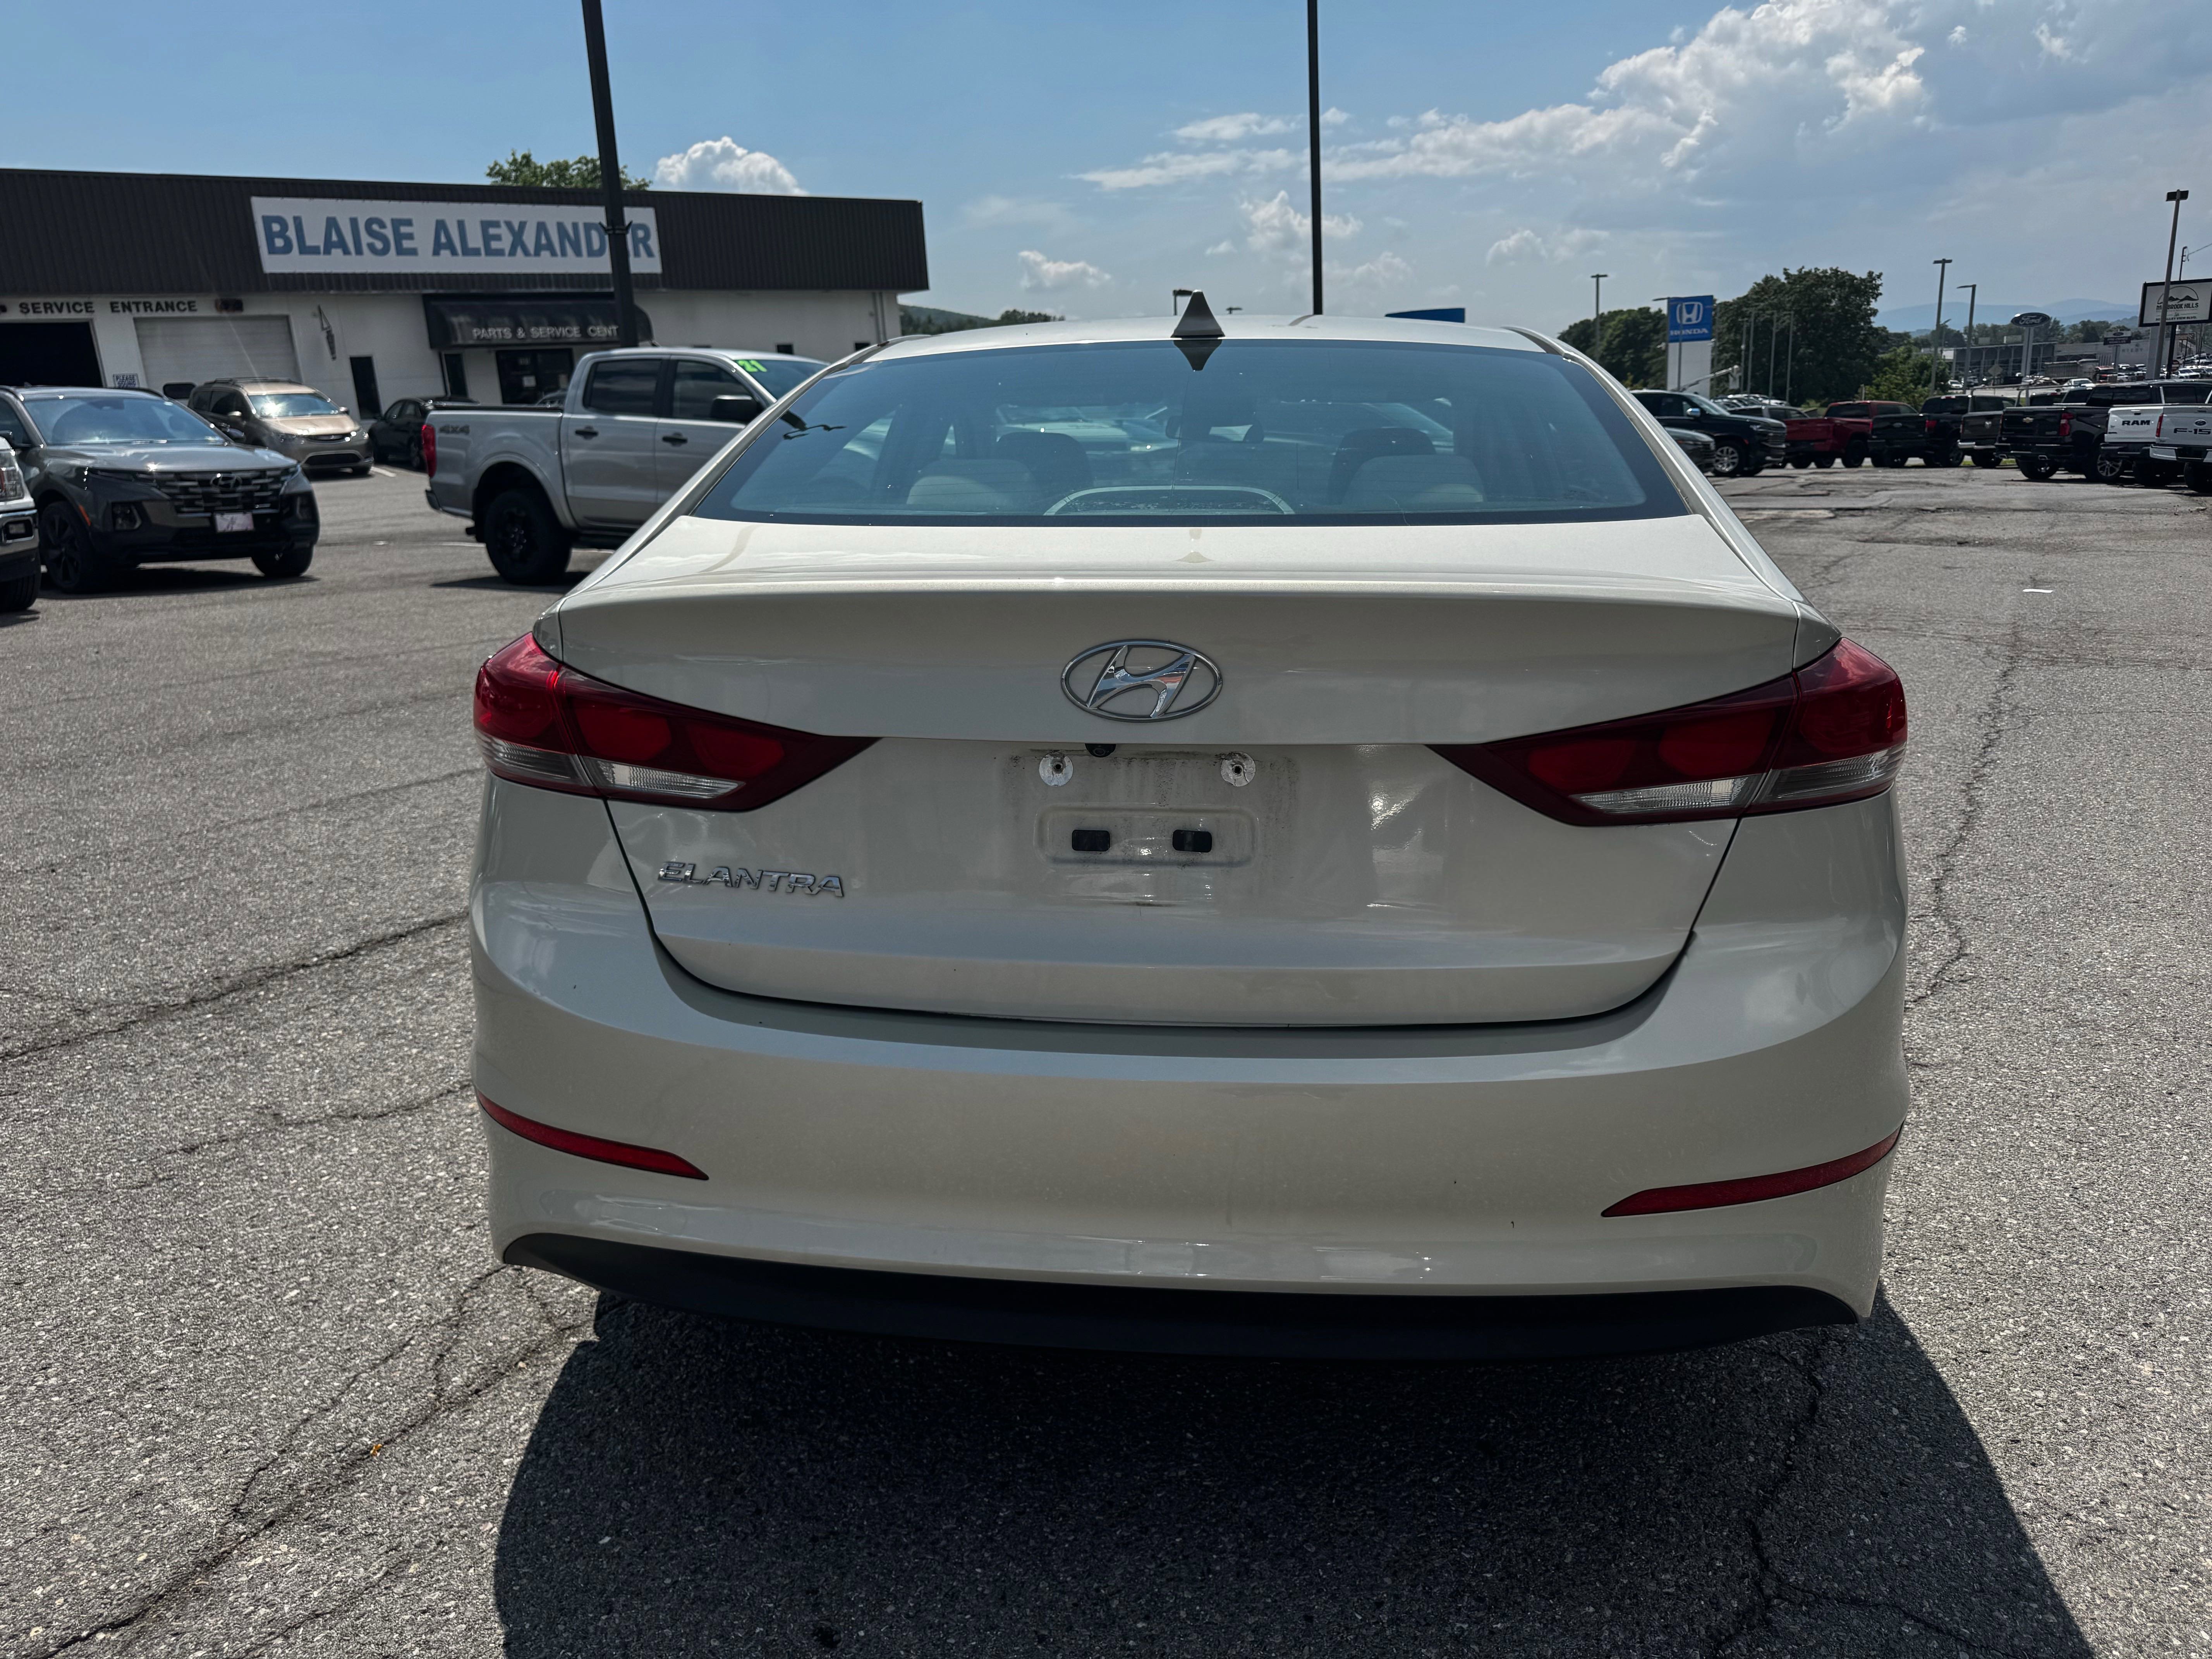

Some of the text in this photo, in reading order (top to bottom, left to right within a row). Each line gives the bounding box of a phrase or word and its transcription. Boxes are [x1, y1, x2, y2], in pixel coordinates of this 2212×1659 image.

[262, 215, 656, 258] BLAISE ALEXANDR
[19, 301, 198, 314] SERVICE ENTRANCE
[2019, 316, 2042, 325] Ford
[472, 325, 619, 340] PARTS & SERVICE CENT
[738, 359, 767, 372] 21
[658, 862, 844, 897] ELANTRA
